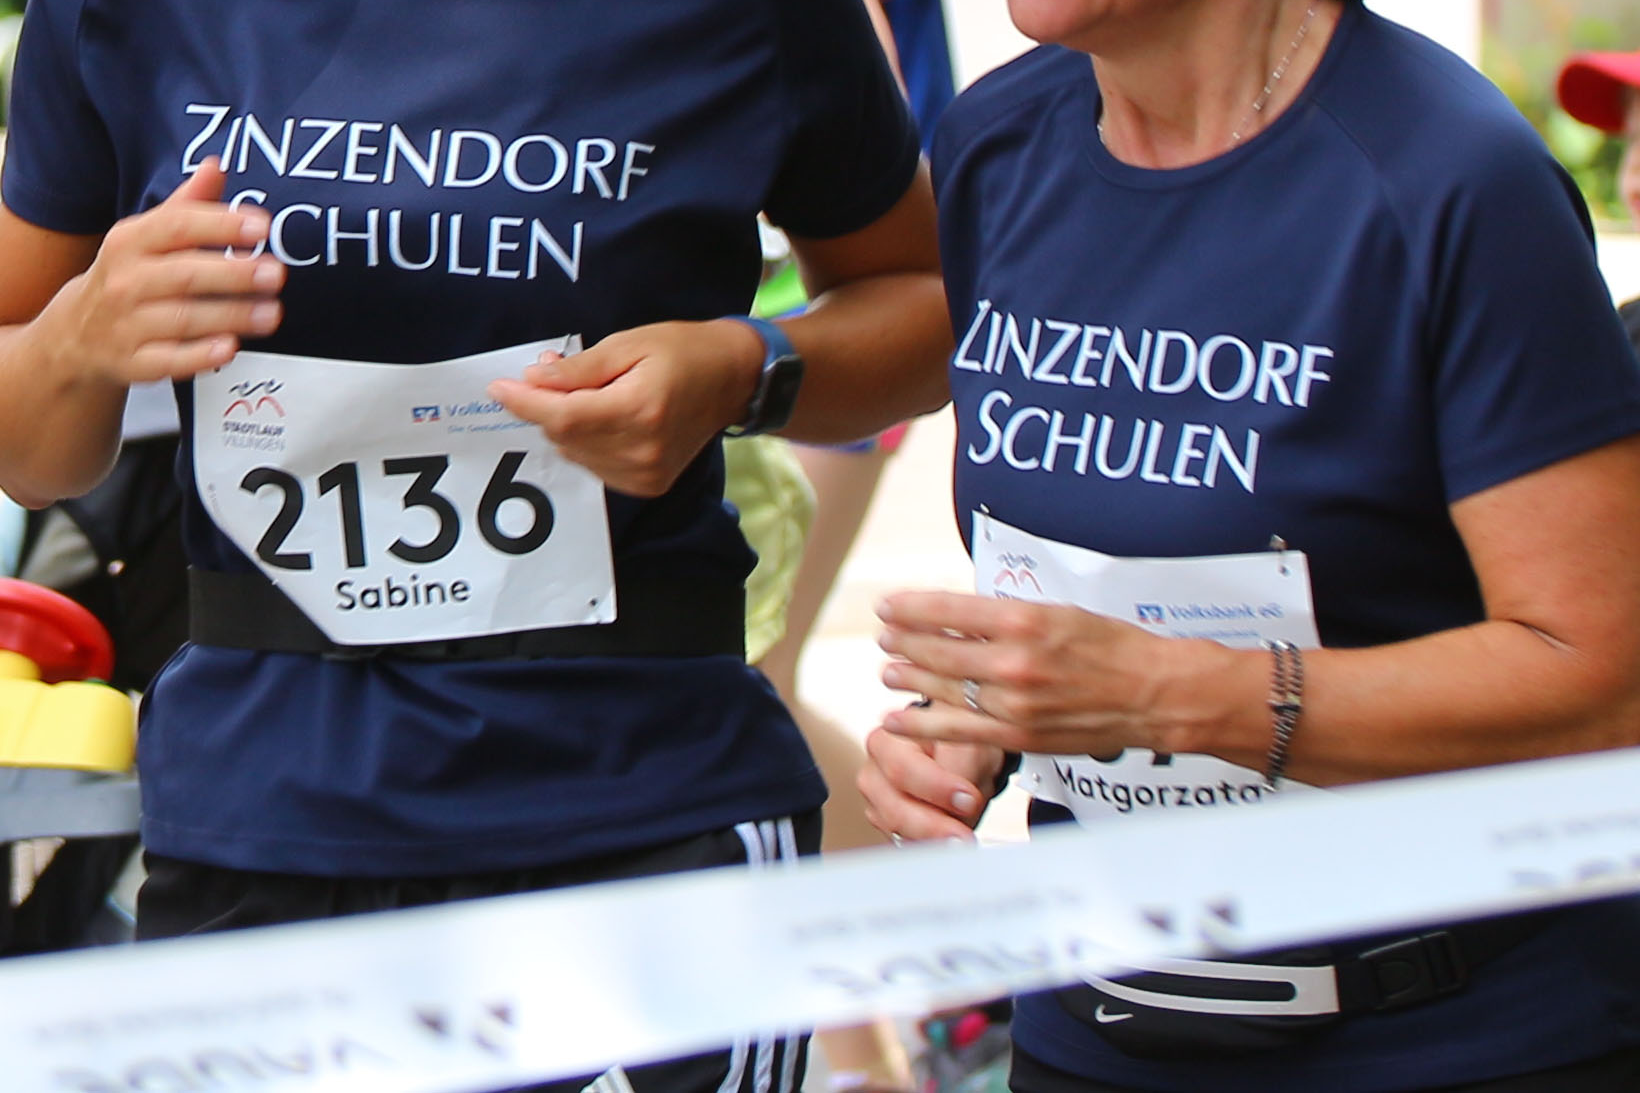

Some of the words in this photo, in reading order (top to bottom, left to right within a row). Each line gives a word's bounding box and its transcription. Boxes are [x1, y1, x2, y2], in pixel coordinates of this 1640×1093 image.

[181, 103, 656, 201] ZINZENDORF
[224, 189, 584, 283] SCHULEN
[953, 299, 1335, 408] ZINZENDORF
[445, 400, 505, 418] Volksb
[967, 390, 1260, 494] SCHULEN
[239, 451, 555, 570] 2136
[335, 574, 472, 612] Sabine
